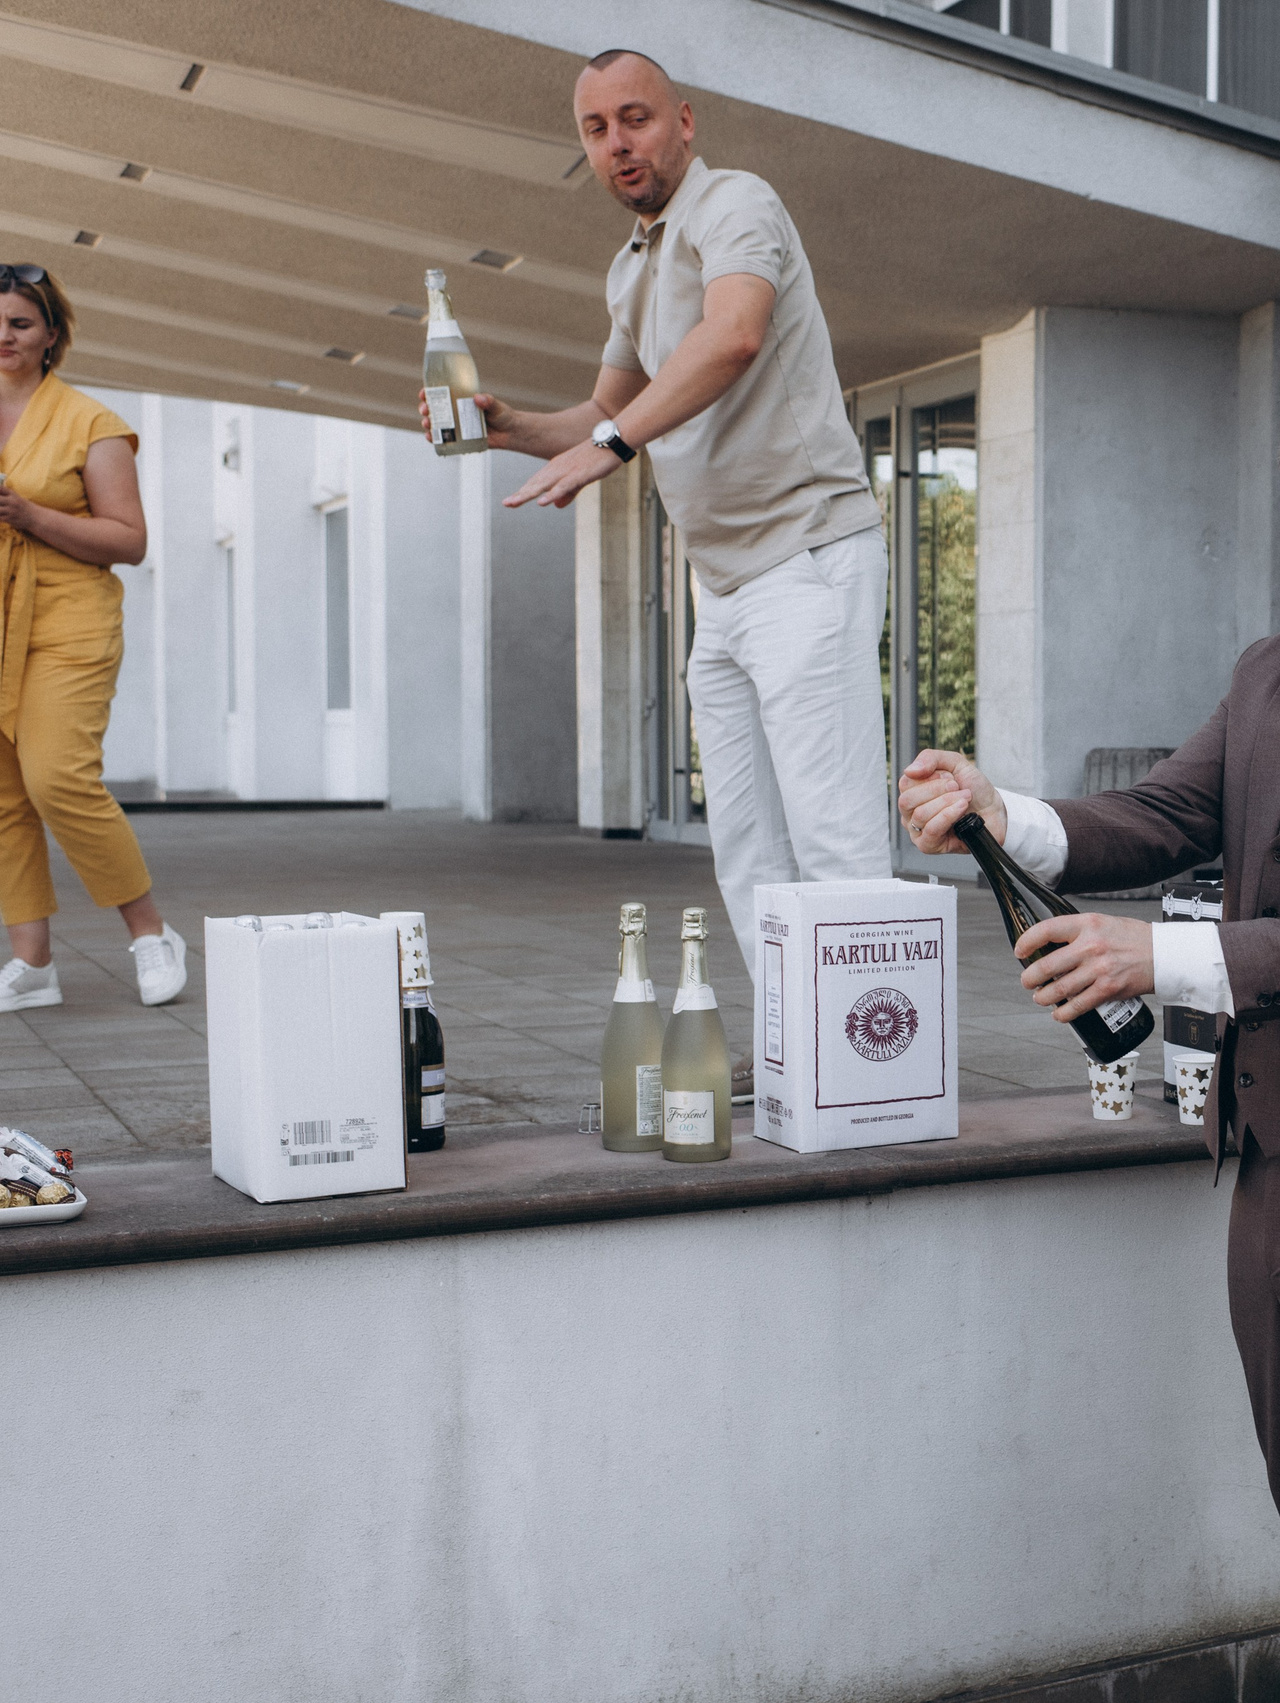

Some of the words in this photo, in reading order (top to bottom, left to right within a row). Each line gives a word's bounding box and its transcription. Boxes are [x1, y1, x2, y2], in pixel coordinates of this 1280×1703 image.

[850, 931, 891, 939] GEORGIAN
[894, 929, 914, 937] WINE
[822, 942, 897, 966] KARTULI
[902, 940, 939, 961] VAZI
[848, 967, 881, 975] LIMITED
[884, 965, 916, 973] EDITION
[854, 1040, 892, 1060] KARTULI
[666, 1106, 708, 1124] Freixenet
